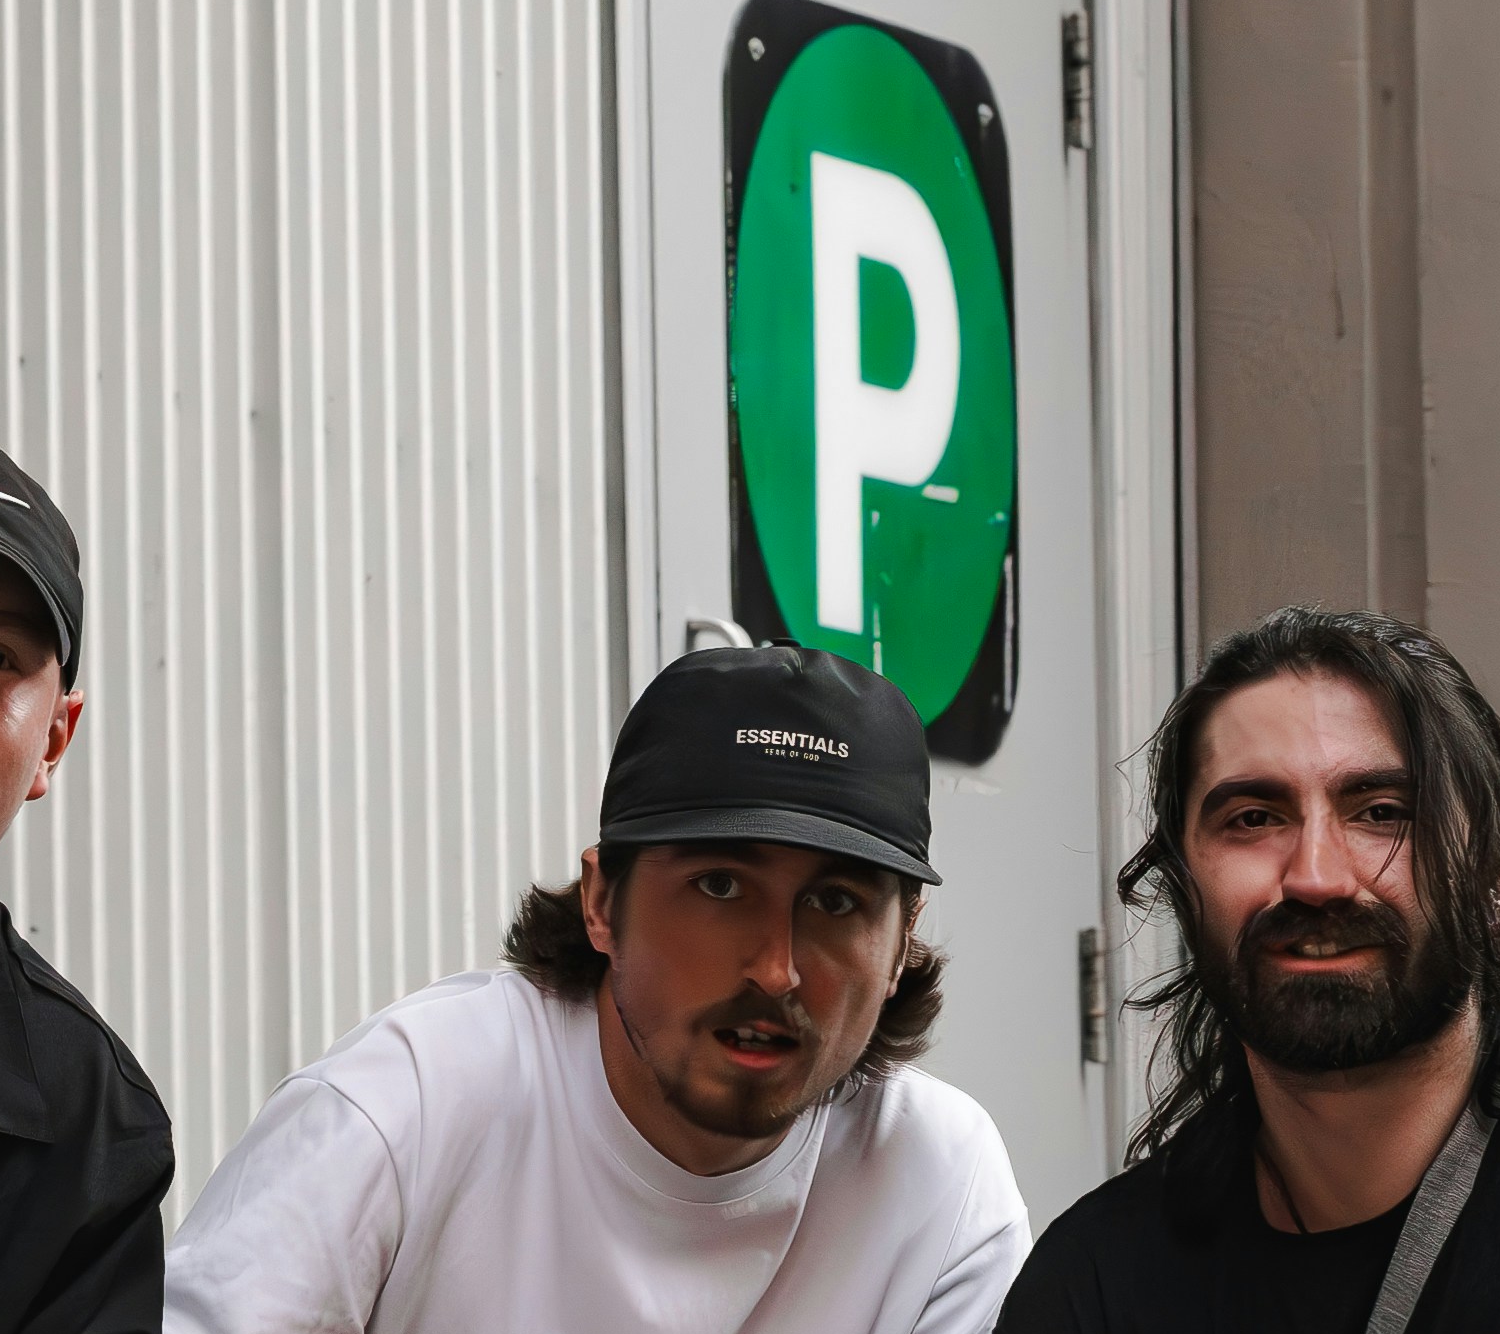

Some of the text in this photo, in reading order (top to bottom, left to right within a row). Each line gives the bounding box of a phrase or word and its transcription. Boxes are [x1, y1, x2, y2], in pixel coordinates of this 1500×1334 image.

[811, 151, 961, 634] P
[736, 729, 849, 758] ESSENTIALS
[803, 752, 820, 762] GOD
